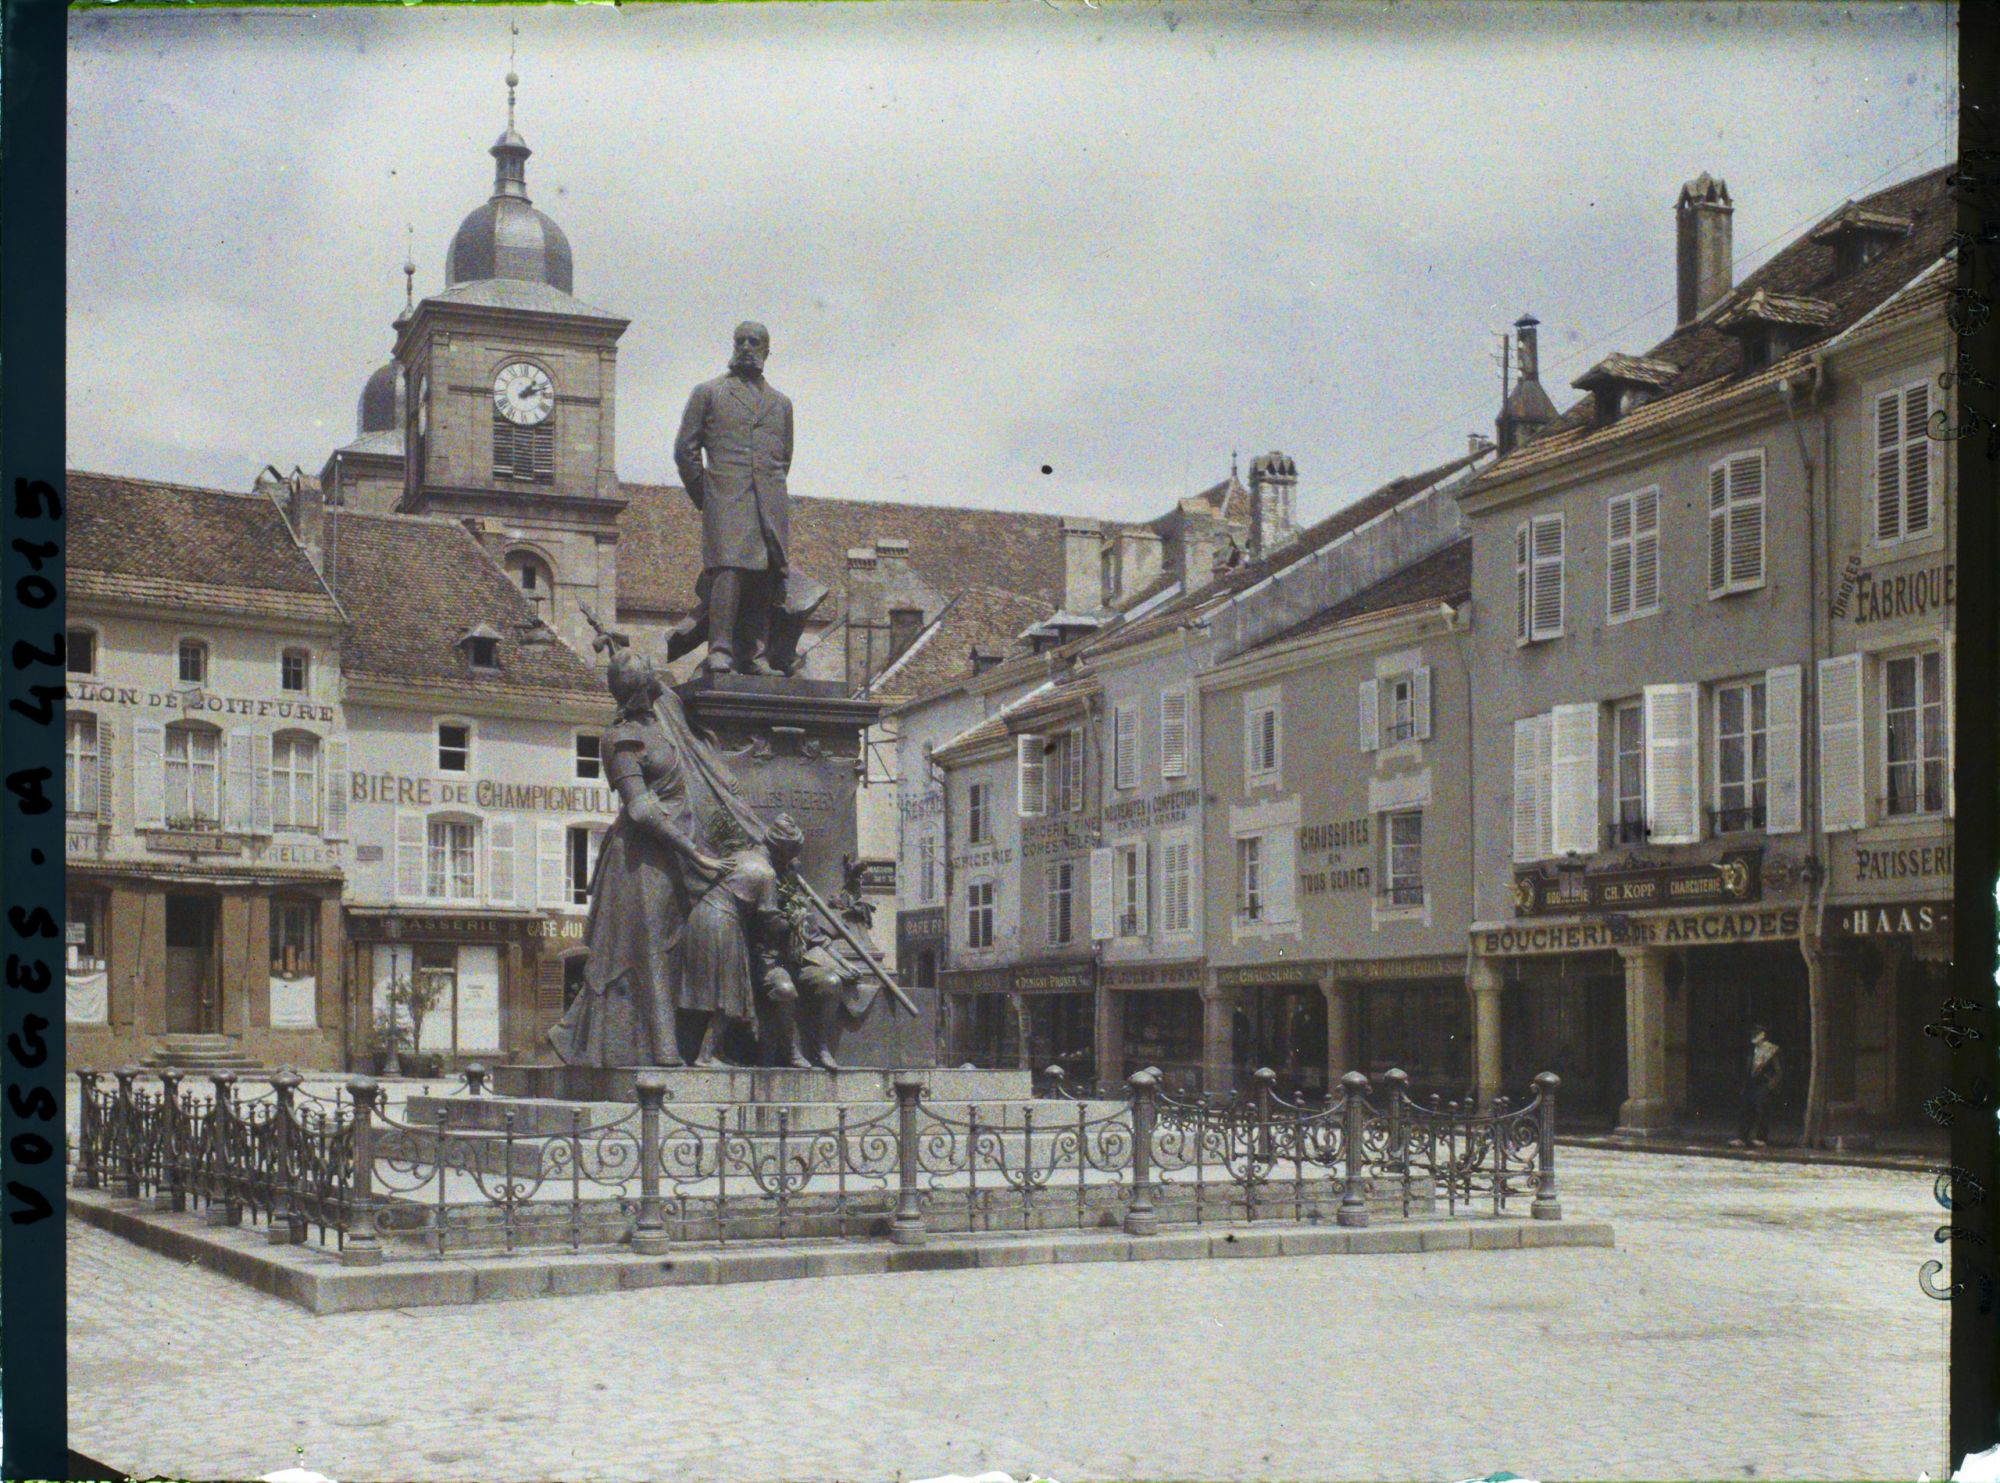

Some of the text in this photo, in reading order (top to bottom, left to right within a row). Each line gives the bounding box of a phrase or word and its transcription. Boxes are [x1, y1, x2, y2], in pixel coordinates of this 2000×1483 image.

[1855, 564, 1955, 625] FABRIQUE
[150, 694, 178, 708] DE
[352, 772, 432, 804] BIÈRE
[442, 785, 470, 804] DE
[1623, 882, 1657, 899] KOPP
[1666, 911, 1799, 941] ARCADES
[1853, 906, 1934, 936] HAAS
[6, 903, 62, 1226] VOSGES
